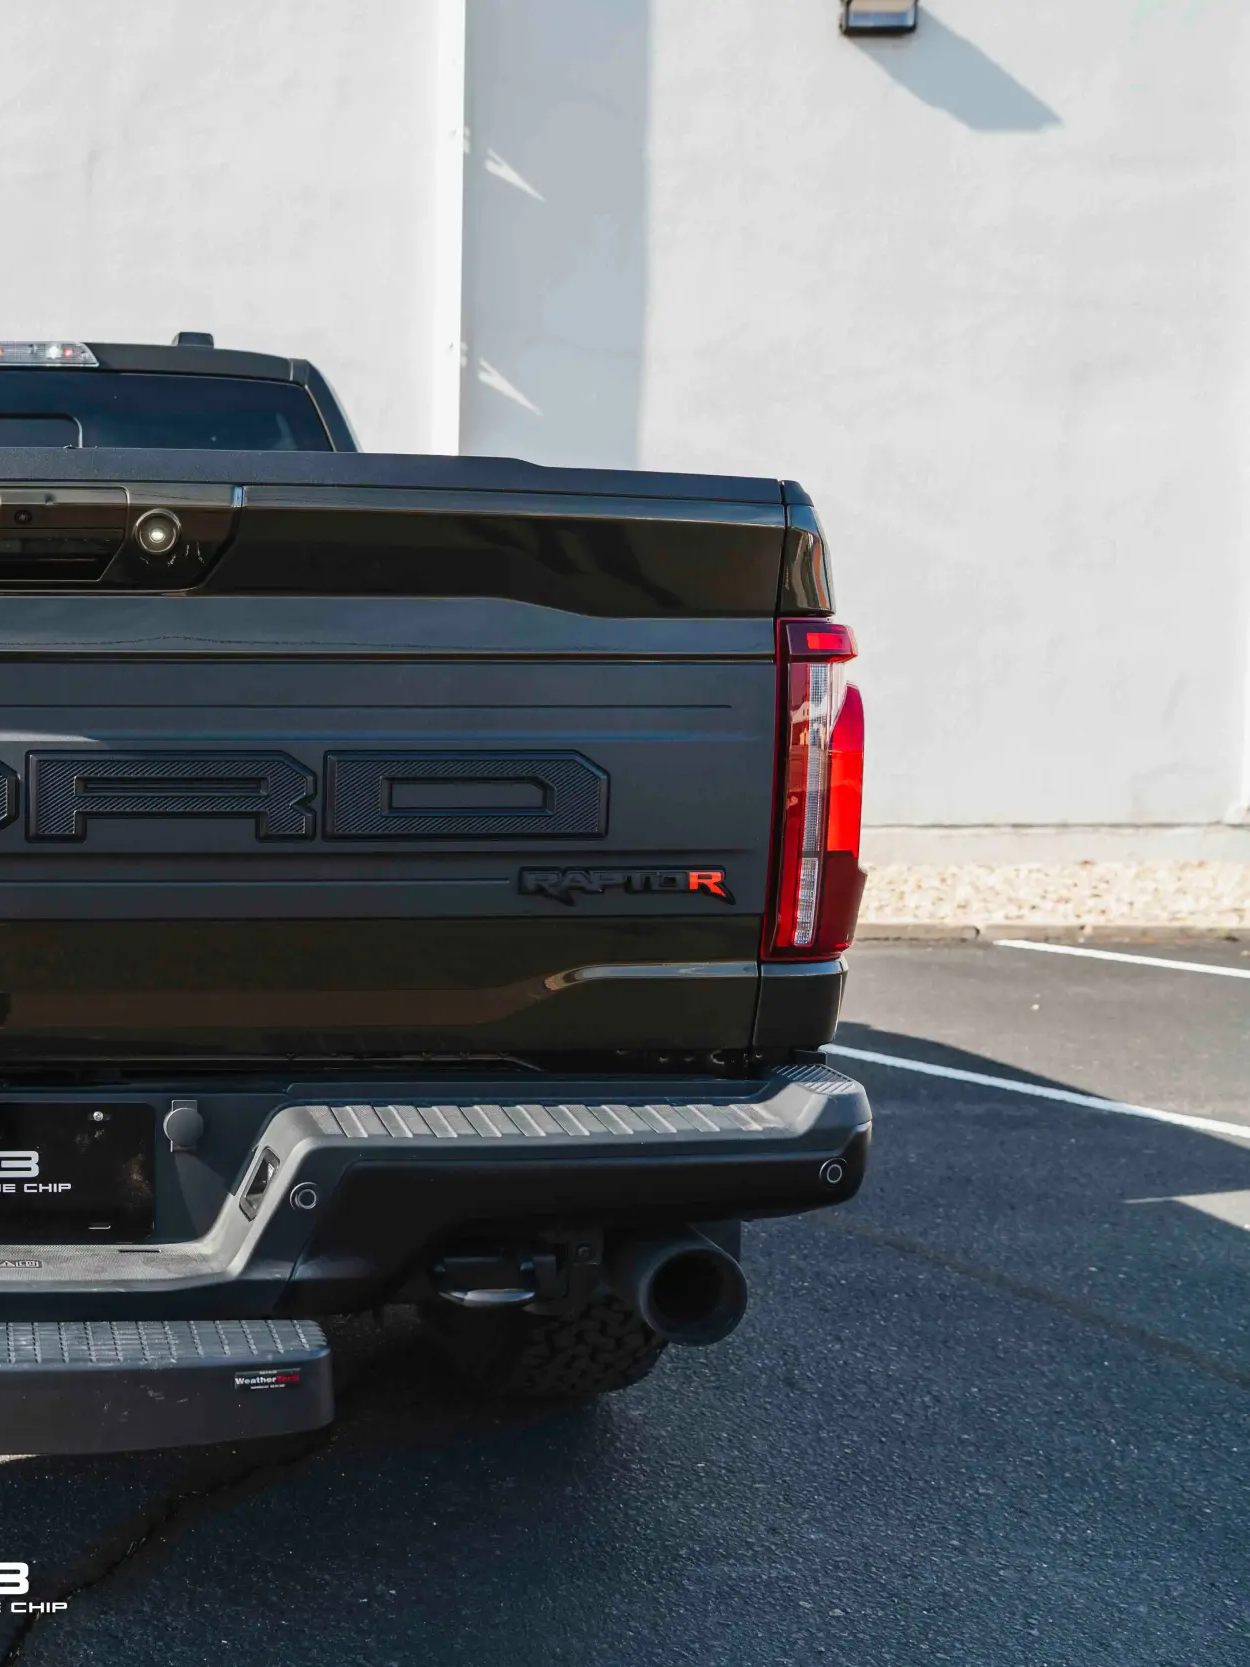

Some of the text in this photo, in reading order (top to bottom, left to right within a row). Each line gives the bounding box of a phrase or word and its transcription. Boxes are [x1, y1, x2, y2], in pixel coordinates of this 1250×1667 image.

[517, 865, 736, 906] RAPTOR
[23, 1182, 72, 1193] CHIP
[234, 1374, 300, 1385] WeatherT
